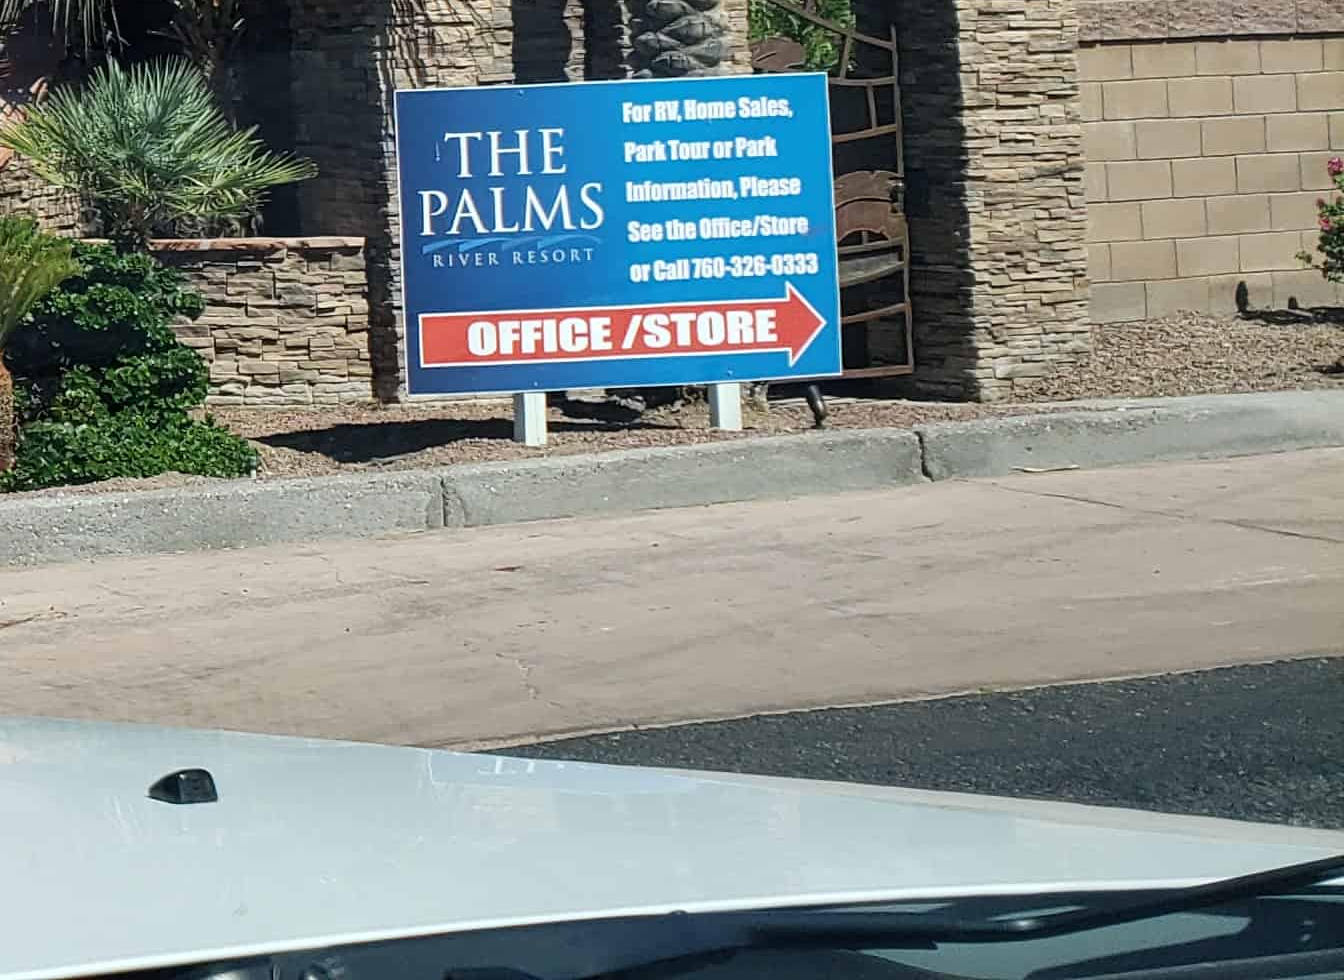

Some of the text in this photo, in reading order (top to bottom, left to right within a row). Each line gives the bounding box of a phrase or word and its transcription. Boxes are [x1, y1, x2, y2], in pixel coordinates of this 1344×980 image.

[622, 96, 793, 123] For RV, Home Sales,
[444, 127, 567, 178] THE
[624, 136, 778, 163] Park Tour or Park
[625, 176, 801, 202] Information, Please
[417, 182, 604, 236] PALMS
[627, 215, 809, 242] See the Office/Store
[433, 248, 594, 268] RIVER RESORT
[630, 252, 819, 282] or Call 760-326-0333
[467, 309, 778, 356] OFFICE /STORE
